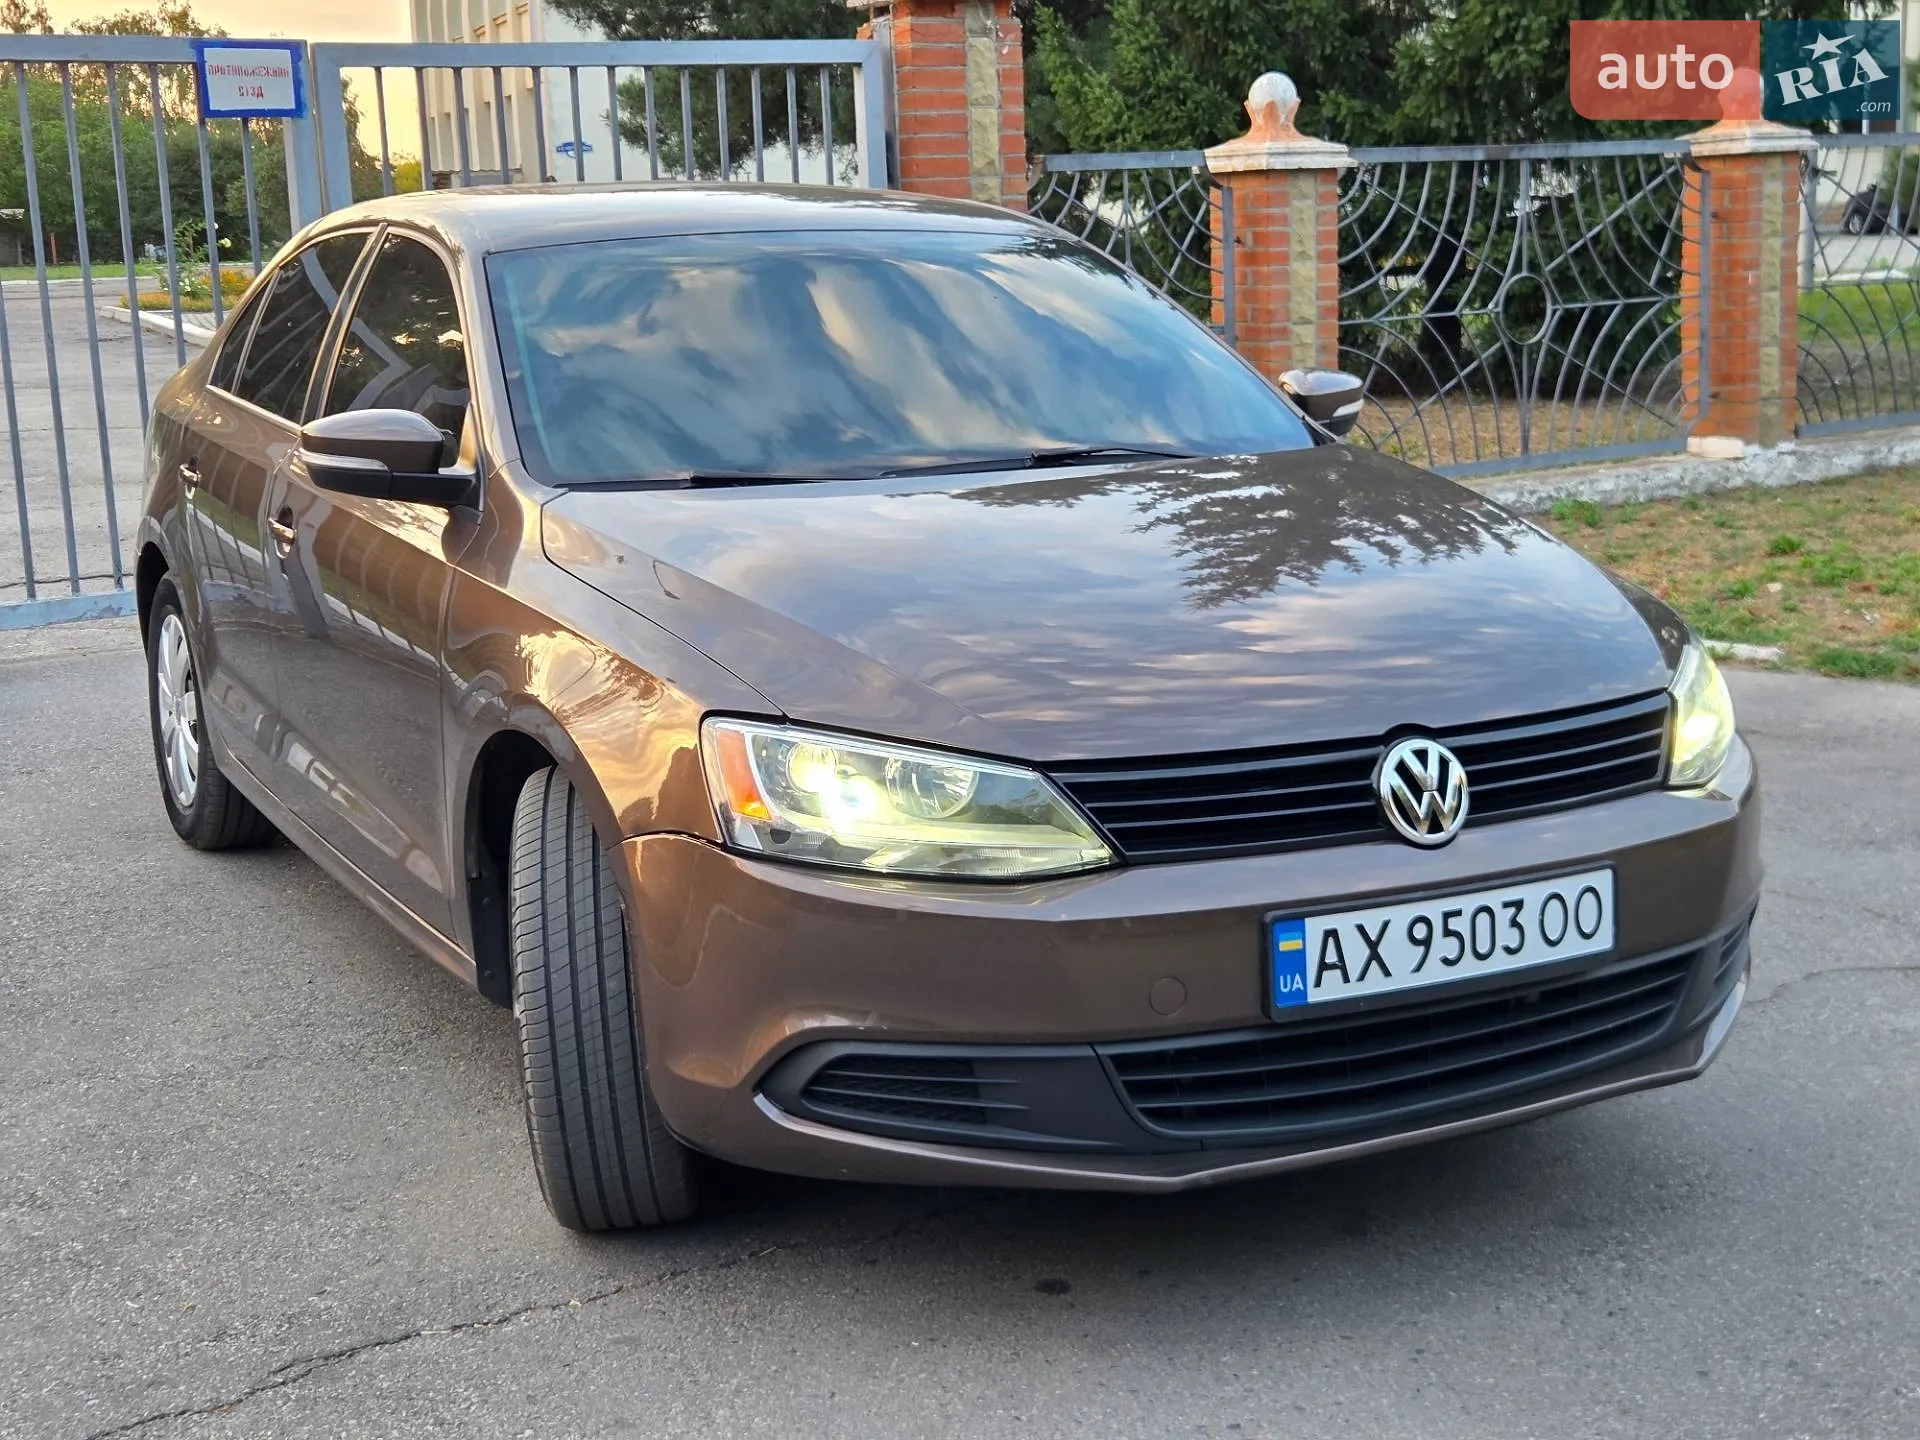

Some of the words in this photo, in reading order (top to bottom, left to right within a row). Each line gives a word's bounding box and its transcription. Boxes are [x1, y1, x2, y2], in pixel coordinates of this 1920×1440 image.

[1313, 918, 1393, 988] AX
[1406, 897, 1526, 973] 9503
[1279, 973, 1305, 993] UA
